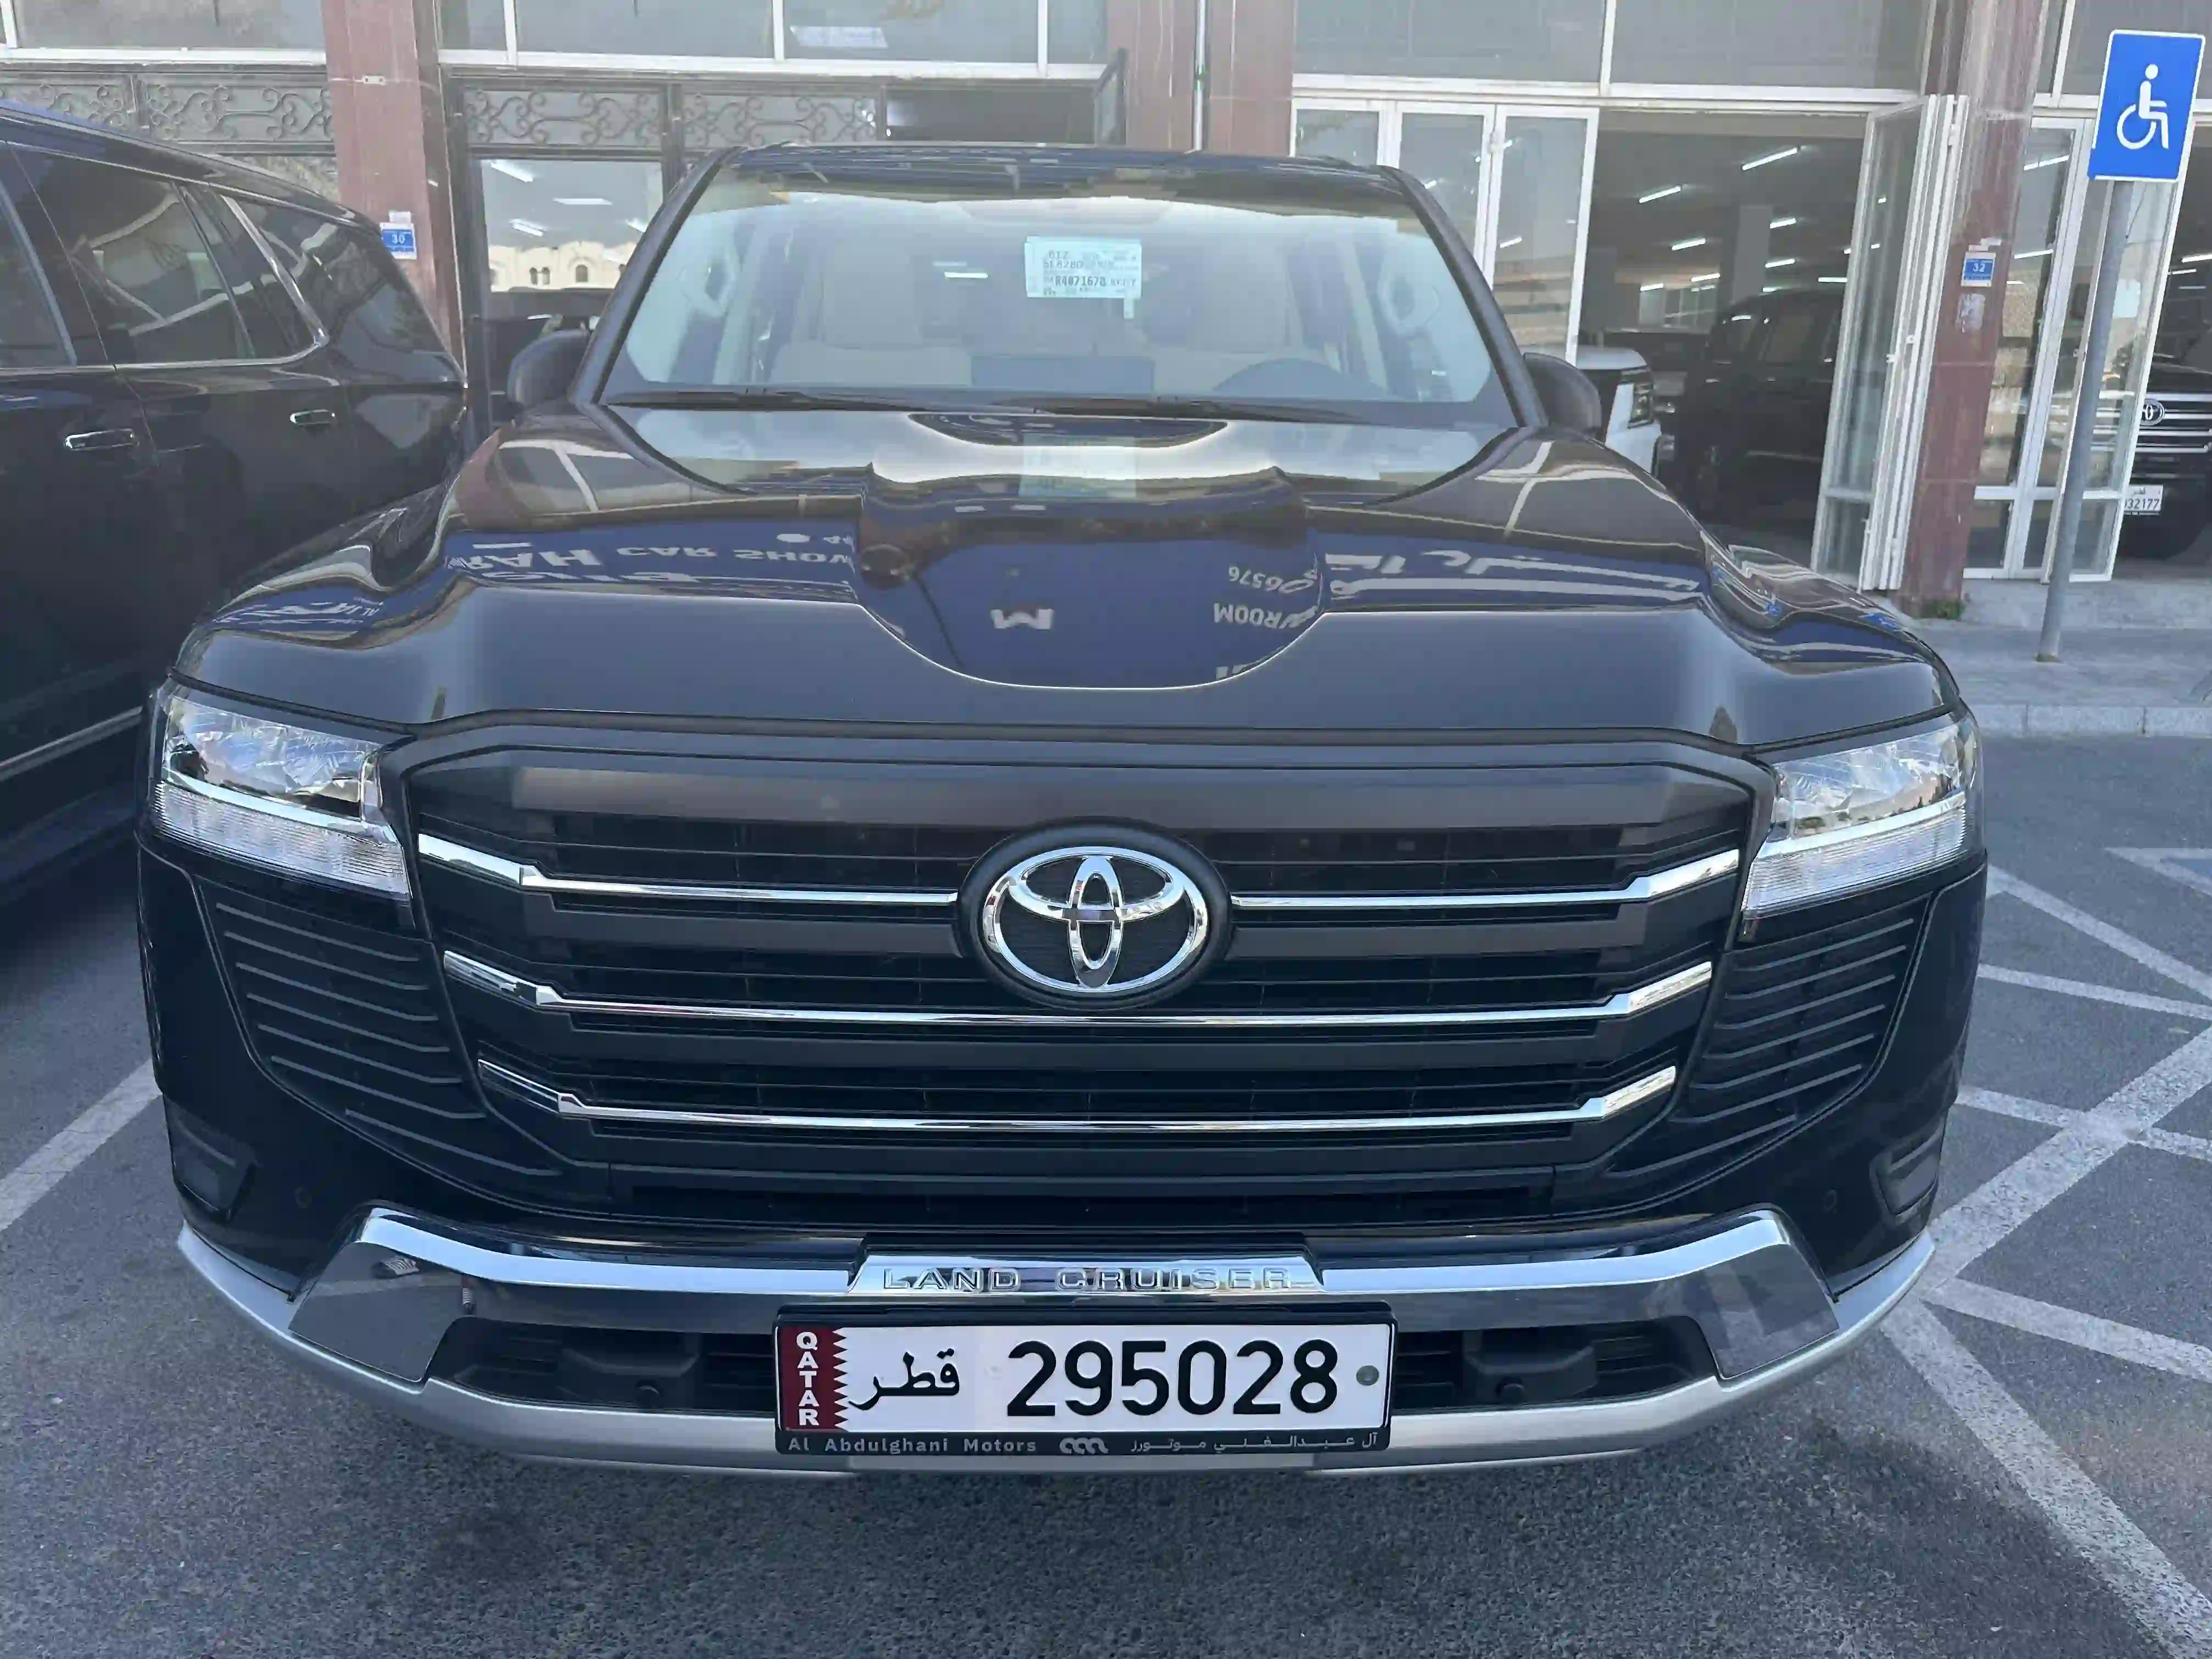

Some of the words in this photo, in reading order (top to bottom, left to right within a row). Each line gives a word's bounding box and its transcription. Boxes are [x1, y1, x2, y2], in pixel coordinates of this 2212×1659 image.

[1973, 263, 1985, 272] 32
[2124, 498, 2160, 510] 32177
[883, 1266, 1021, 1293] LAND
[1055, 1266, 1292, 1292] CRUISER
[796, 1332, 819, 1426] QATAR
[848, 1348, 960, 1410] قطر
[1007, 1339, 1338, 1416] 295028
[789, 1437, 809, 1451] Al
[825, 1437, 948, 1454] Abdulghani
[964, 1438, 1036, 1452] Motors
